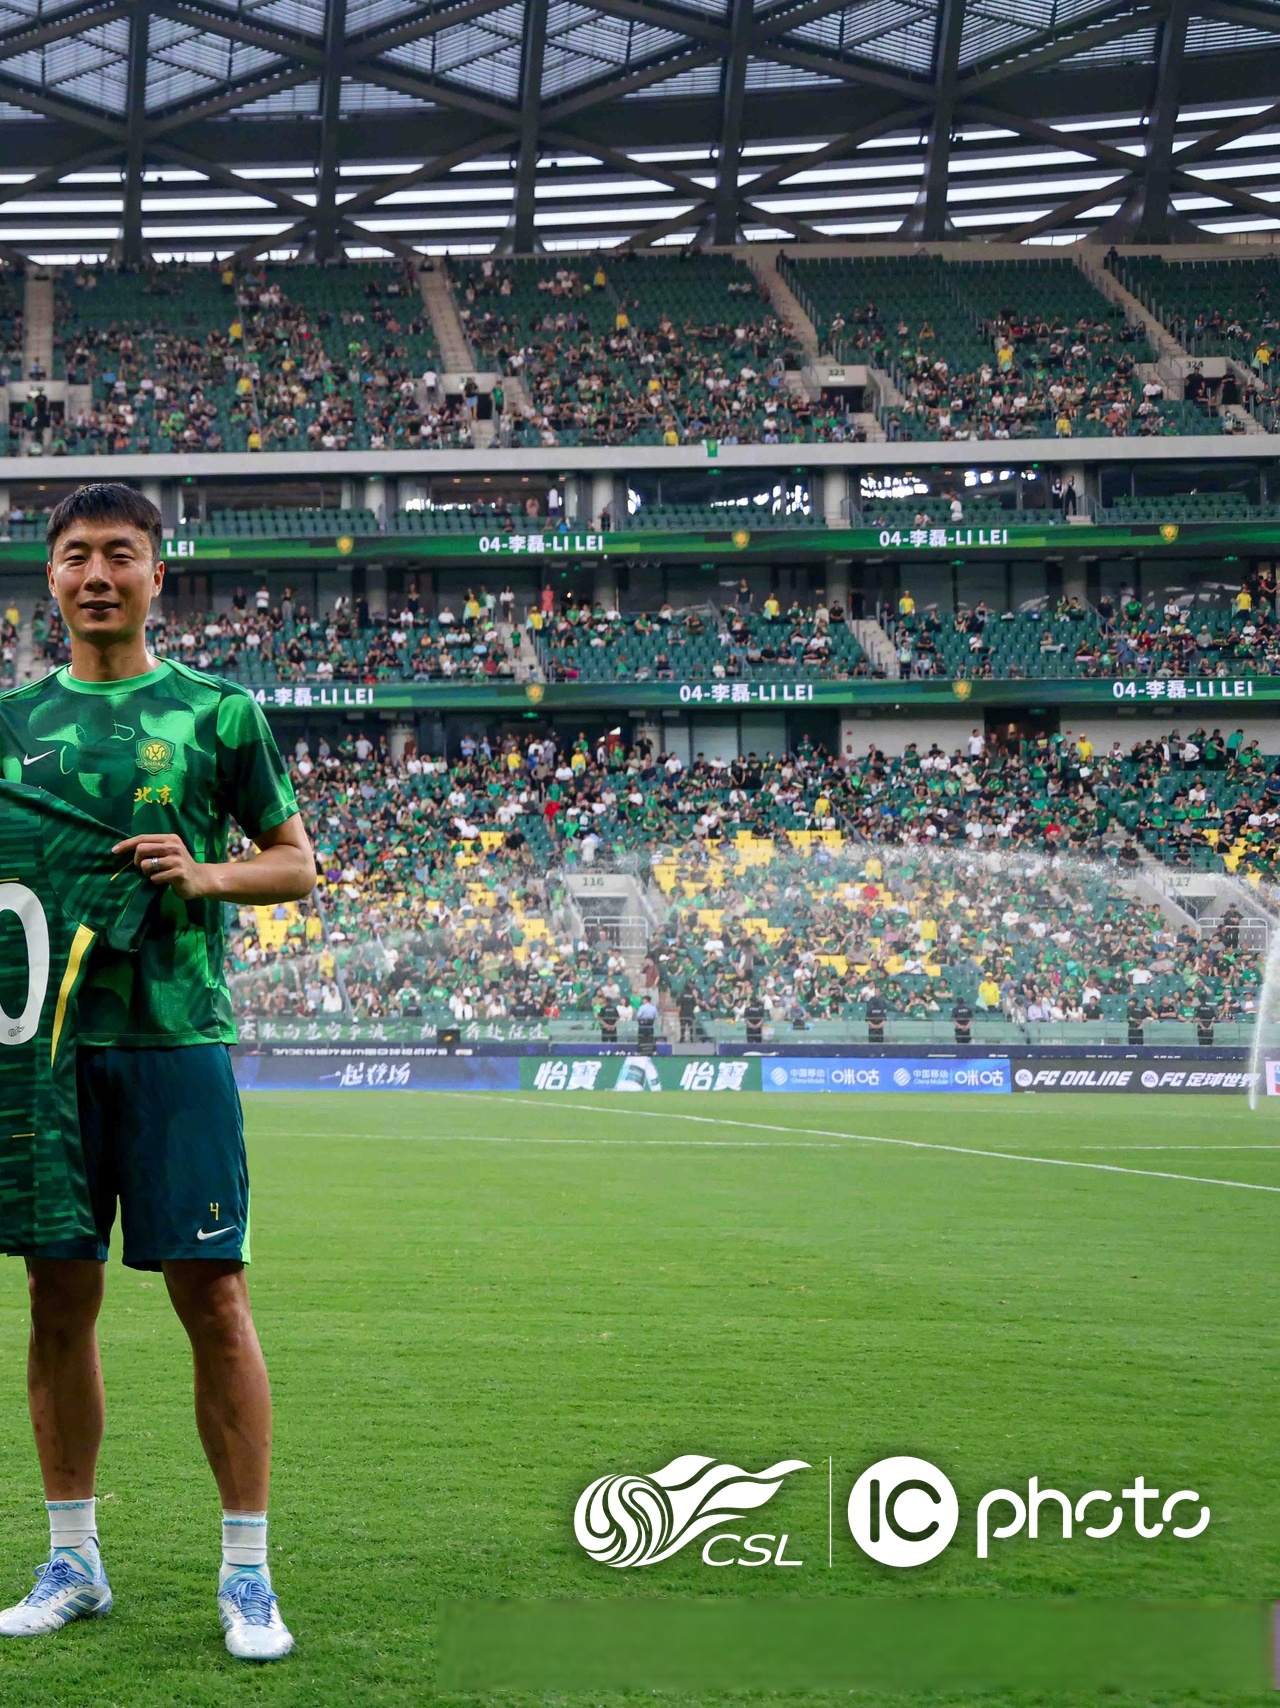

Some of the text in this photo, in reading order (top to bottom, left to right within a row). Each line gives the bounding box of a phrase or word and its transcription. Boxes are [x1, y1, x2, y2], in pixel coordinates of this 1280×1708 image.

[575, 535, 603, 551] LEI
[979, 529, 1007, 545] LEI
[167, 541, 195, 557] LEI
[344, 688, 373, 705] LEI
[783, 684, 813, 701] LEI
[1222, 681, 1253, 697] LEI
[133, 784, 174, 806] 北京
[420, 1021, 549, 1042] 纵奔赴征途
[790, 1068, 826, 1078] 中国移动
[831, 1068, 880, 1086] 咪咕
[913, 1069, 949, 1078] 中国移动
[954, 1069, 1004, 1087] 咪咕
[1032, 1071, 1061, 1086] FC
[1060, 1070, 1134, 1086] ONLINE
[1158, 1072, 1183, 1087] FC
[210, 1202, 219, 1220] 4
